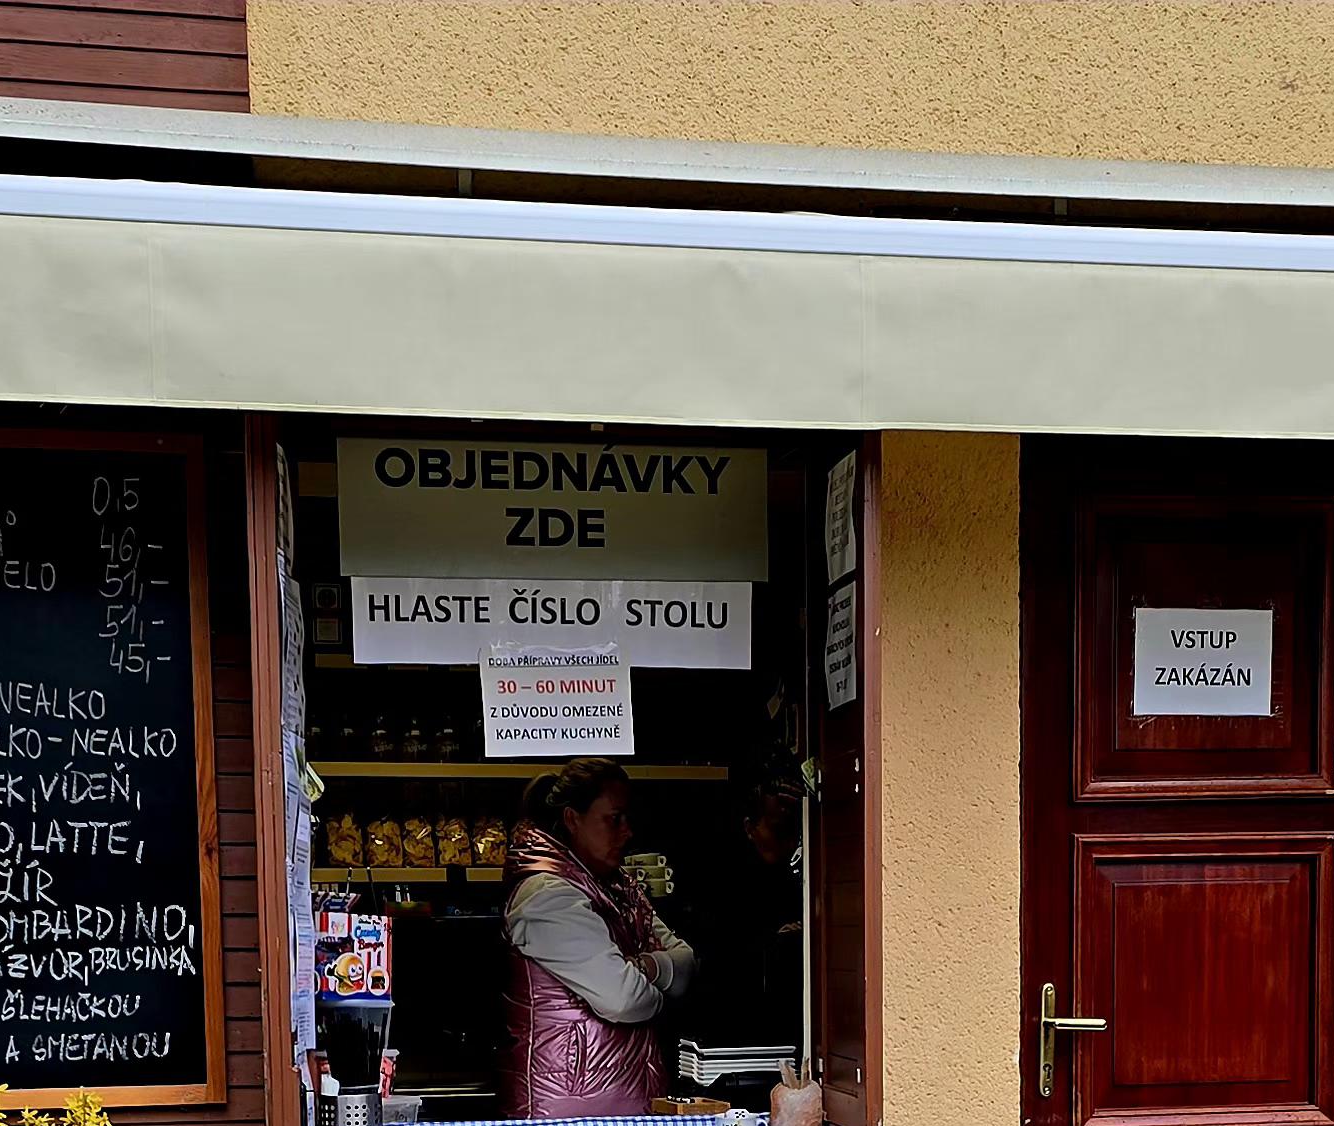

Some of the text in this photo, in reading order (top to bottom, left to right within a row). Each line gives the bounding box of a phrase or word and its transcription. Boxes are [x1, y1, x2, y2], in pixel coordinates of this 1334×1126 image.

[374, 441, 731, 495] OBJEDNÁVKY
[505, 506, 605, 547] ZDE
[368, 589, 728, 629] HLASTE ČÍSLO STOLU
[1171, 630, 1237, 649] VSTUP
[488, 657, 515, 667] DOBA
[566, 655, 594, 666] VŠECH
[596, 654, 619, 665] JÍDEL
[497, 680, 517, 694] 30
[536, 680, 555, 694] 60
[560, 679, 616, 693] MINUT
[1155, 663, 1251, 686] ZAKÁZÁN
[490, 703, 623, 718] Z DŮVODU OMEZENÉ
[496, 725, 620, 740] KAPACITY KUCHYNĚ
[89, 945, 196, 975] BRUSINKA
[1, 989, 140, 1022] ŠLEHAČKOU
[5, 1036, 19, 1064] A
[32, 1032, 170, 1061] SMETANOU
